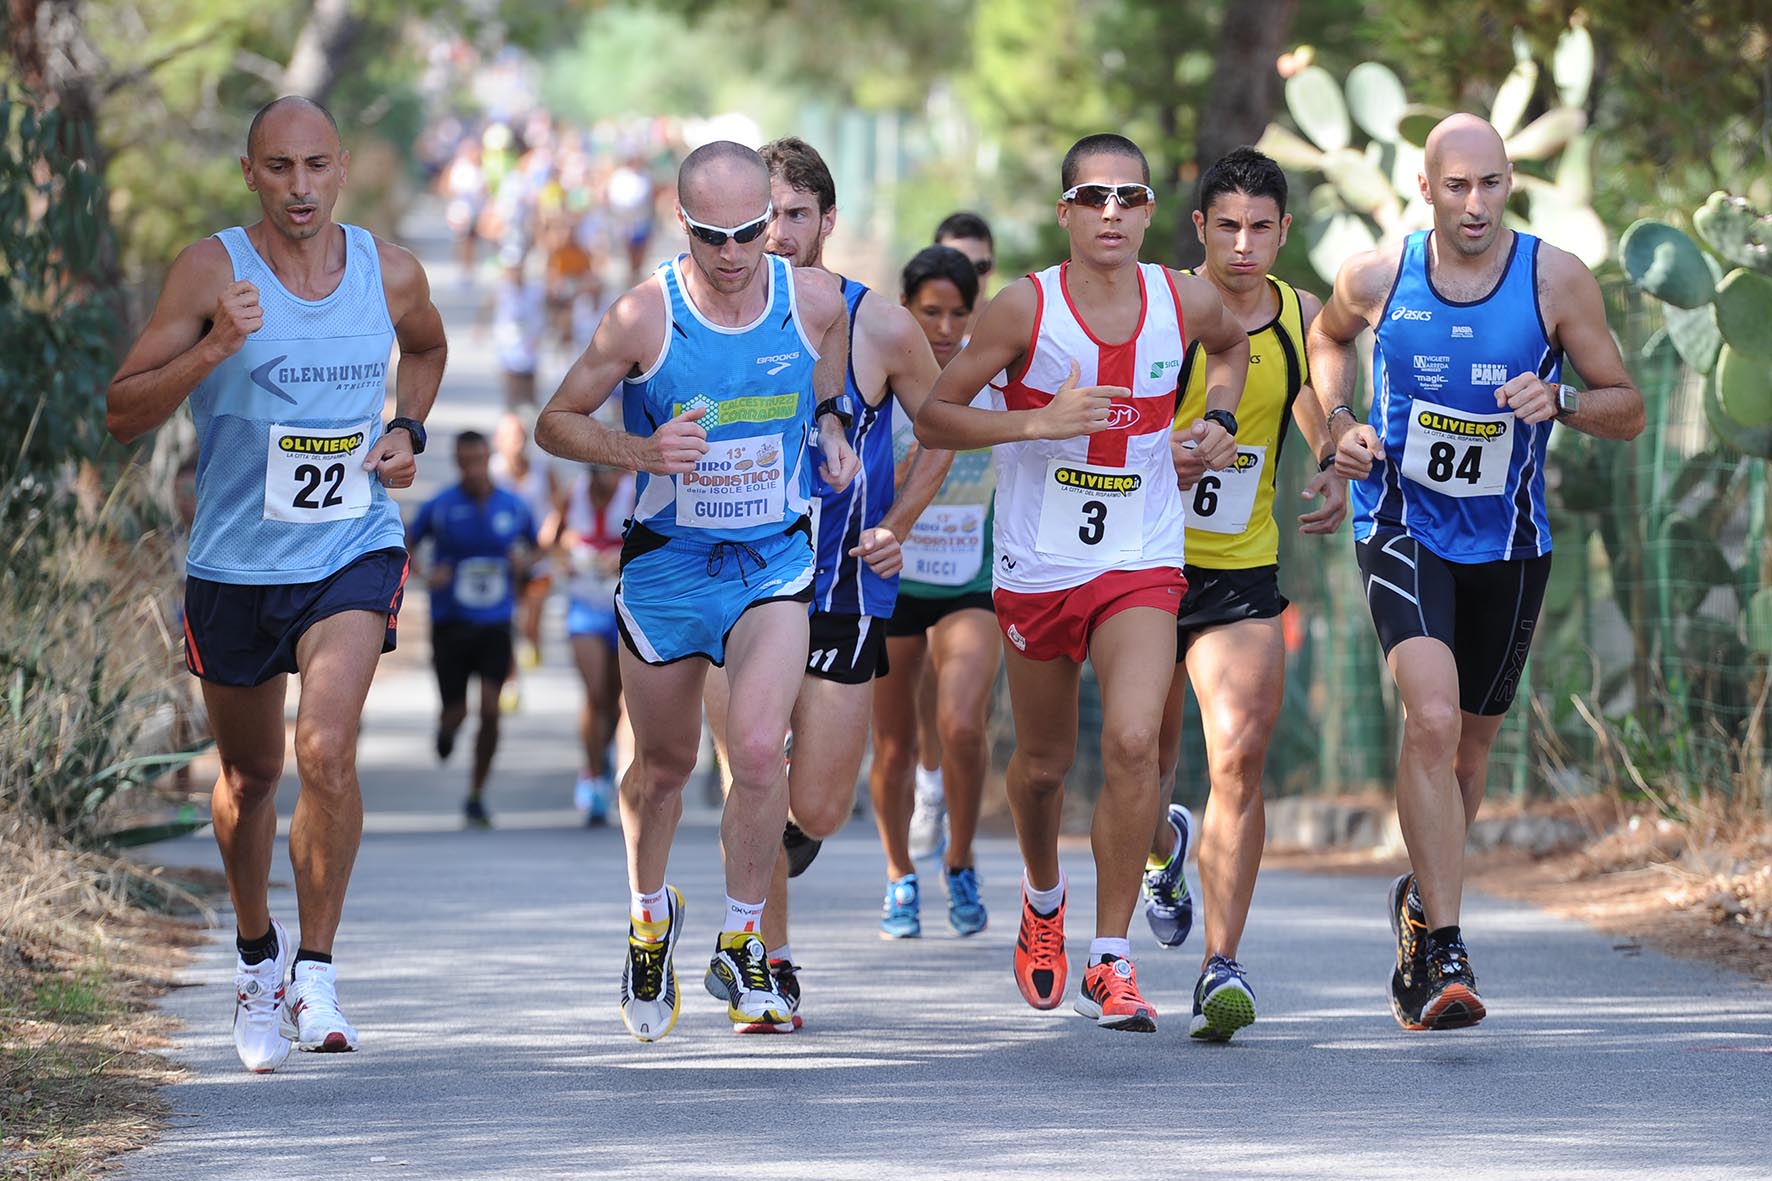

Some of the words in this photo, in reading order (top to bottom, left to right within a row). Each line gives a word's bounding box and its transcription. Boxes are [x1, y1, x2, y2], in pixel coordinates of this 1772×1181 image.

[756, 352, 800, 364] BROOKS
[280, 361, 386, 383] GLENHUNTLY
[1471, 368, 1507, 381] PAM
[1420, 413, 1504, 441] OLIVIERO.it
[281, 435, 363, 455] OLIVIERO.it
[726, 447, 746, 460] 13°
[1427, 441, 1483, 484] 84
[292, 463, 345, 509] 22
[709, 486, 742, 495] ISOLE
[746, 480, 777, 492] EOLIE
[1057, 470, 1140, 496] OLIVIERO.it
[1193, 475, 1221, 517] 6
[694, 498, 768, 518] GUIDETTI
[1079, 500, 1107, 545] 3
[916, 558, 957, 576] RICCI
